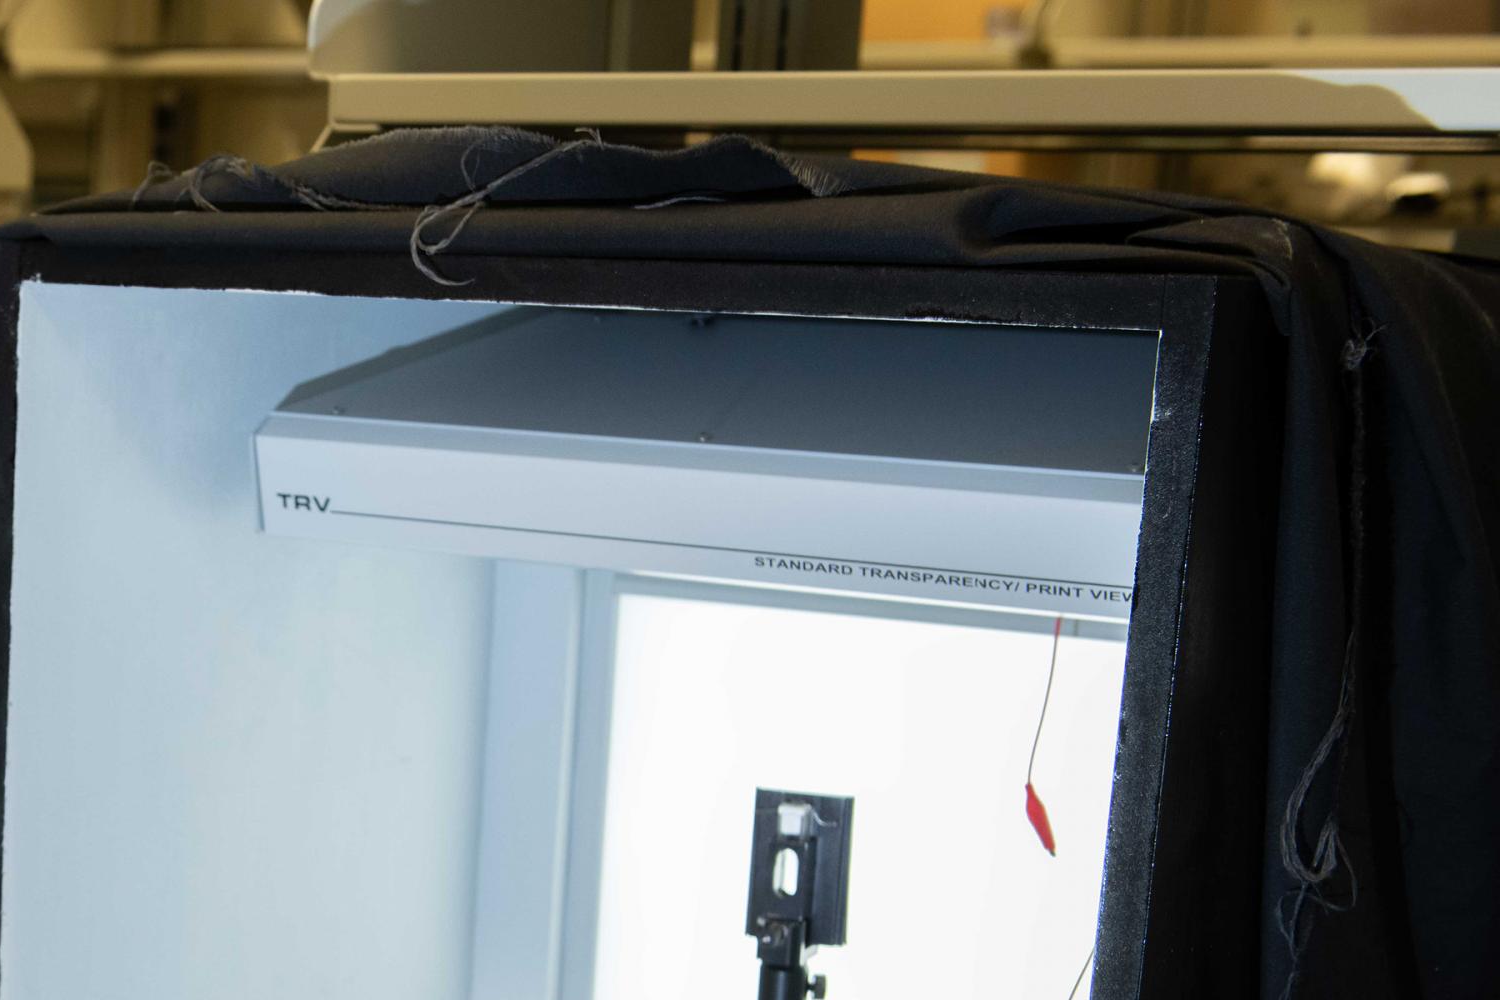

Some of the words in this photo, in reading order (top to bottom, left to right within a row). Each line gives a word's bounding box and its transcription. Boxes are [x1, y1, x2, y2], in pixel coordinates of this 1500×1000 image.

[276, 492, 331, 513] TRV
[754, 556, 853, 576] STANDARD
[1026, 582, 1084, 598] PRINT
